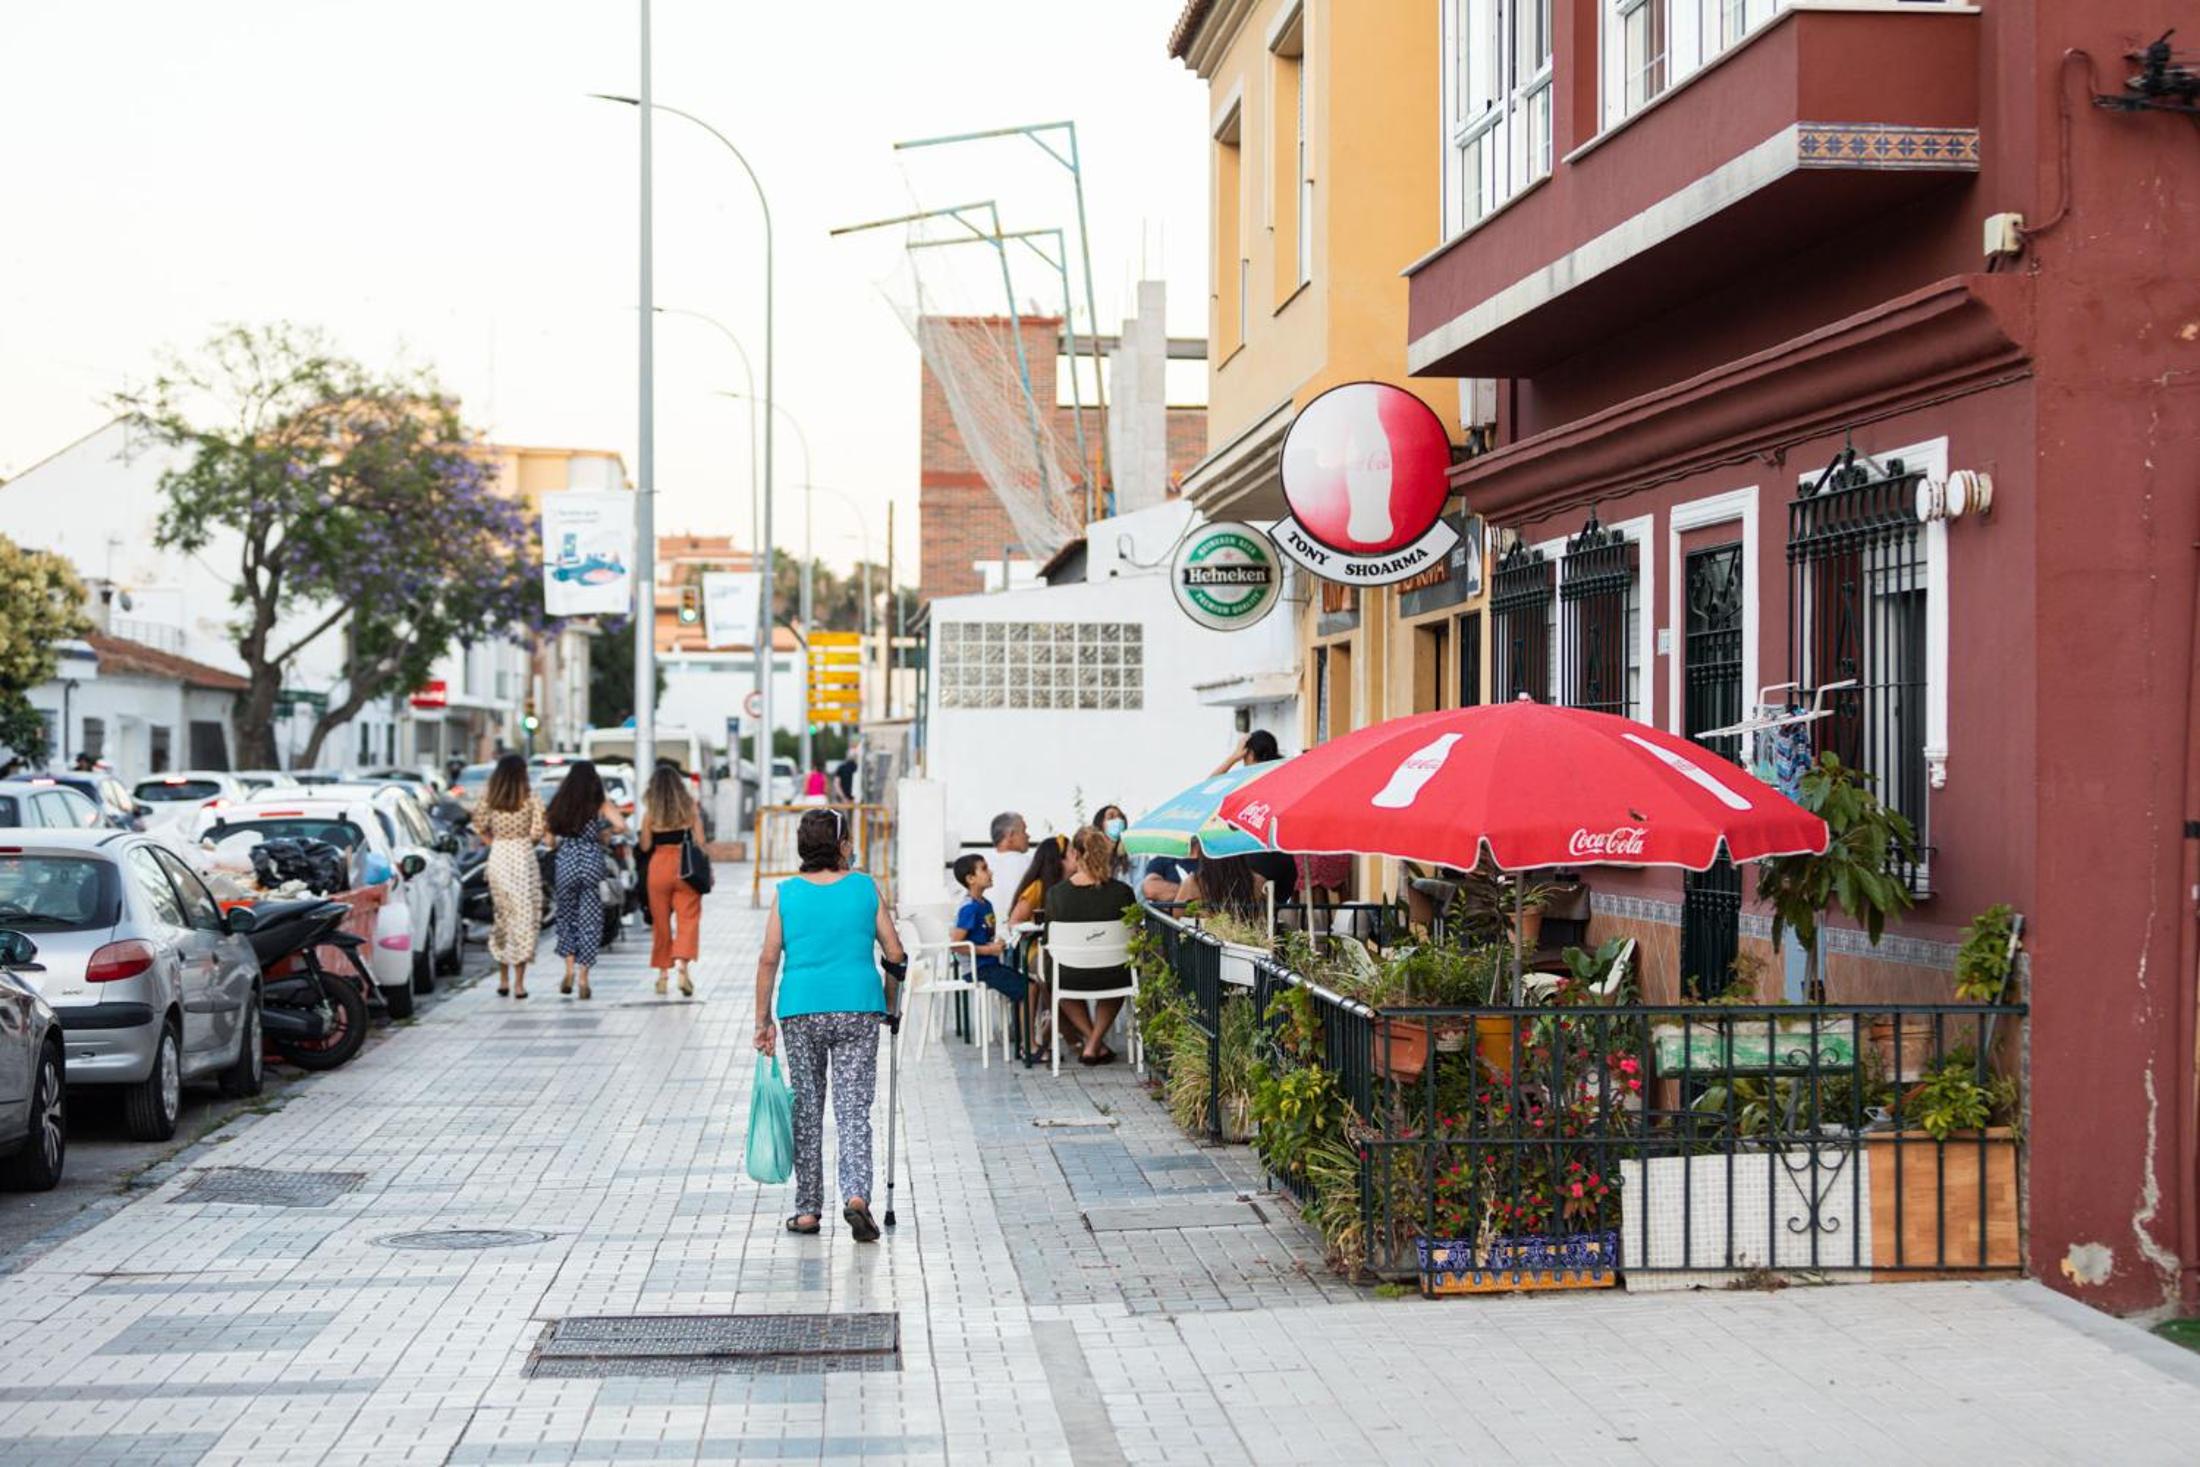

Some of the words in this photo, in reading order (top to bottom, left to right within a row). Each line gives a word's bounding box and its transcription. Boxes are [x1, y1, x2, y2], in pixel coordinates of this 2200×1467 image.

[1288, 531, 1330, 566] TONY
[1344, 548, 1429, 577] SHOARMA
[1189, 567, 1266, 583] Heineken
